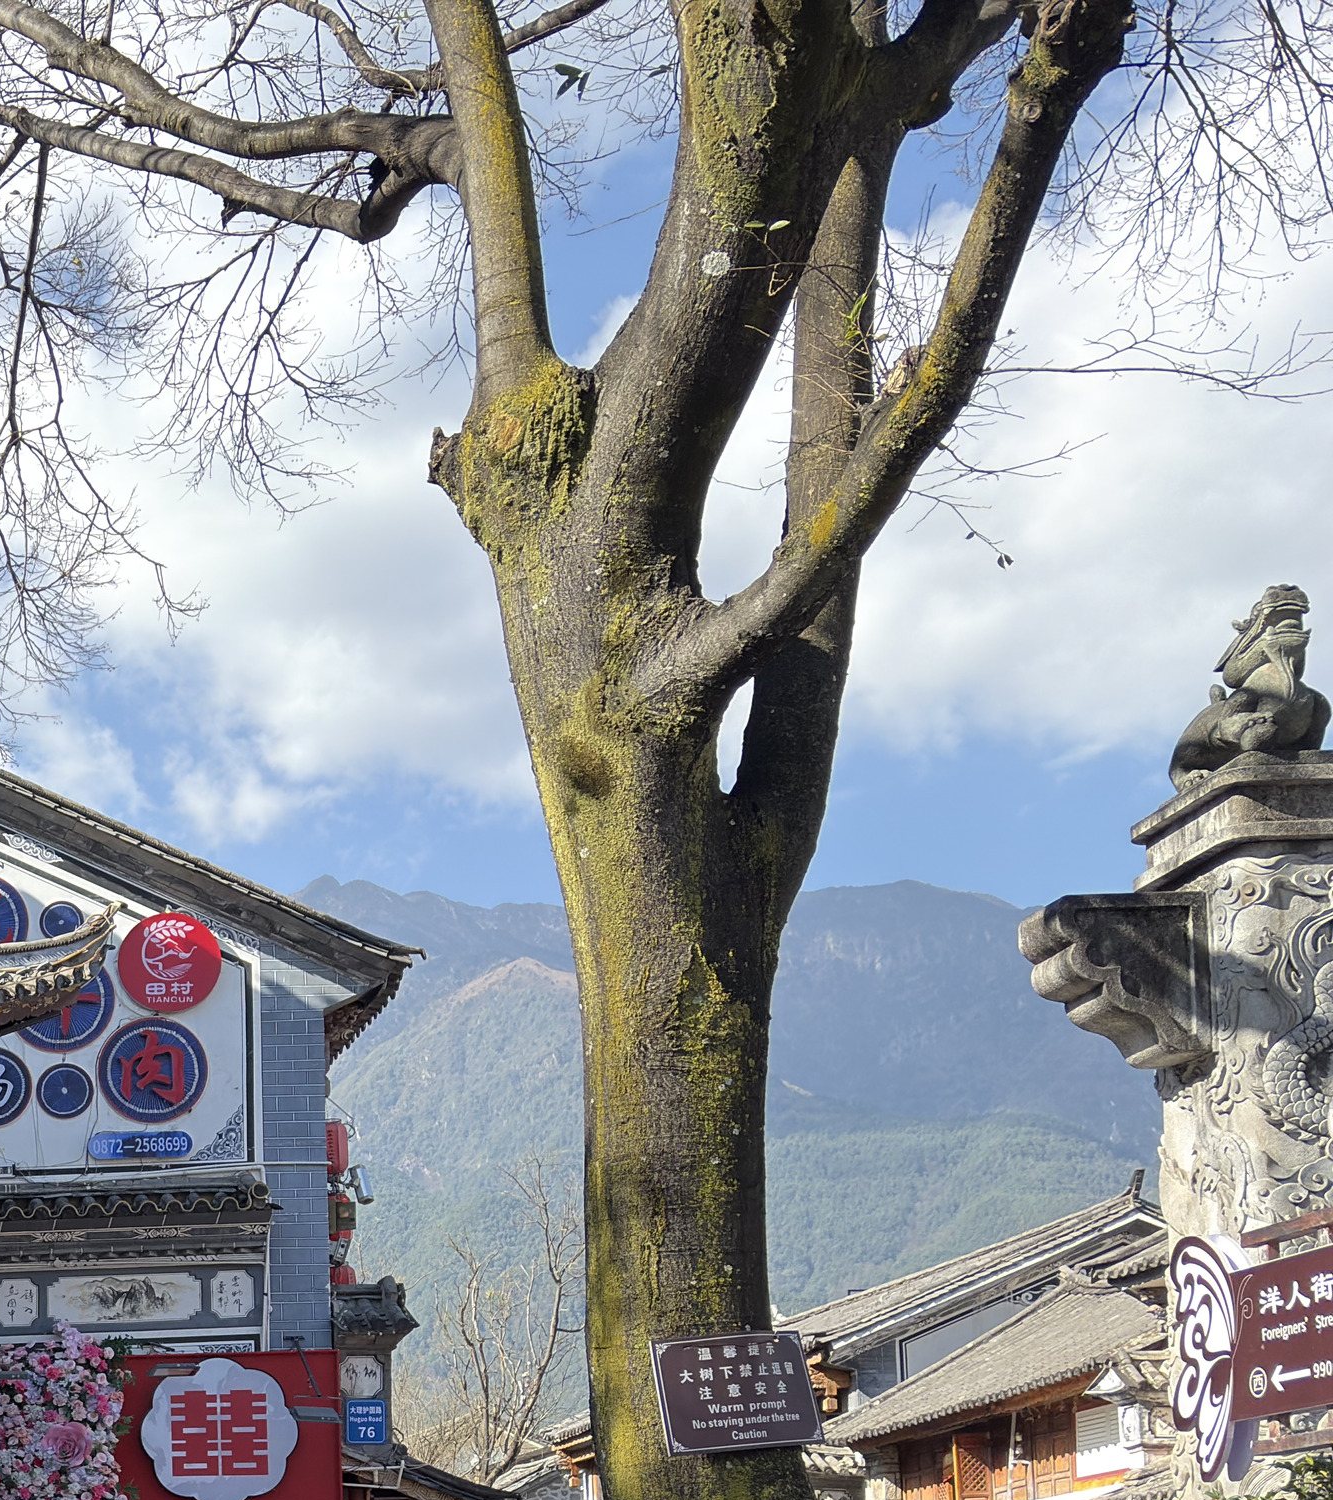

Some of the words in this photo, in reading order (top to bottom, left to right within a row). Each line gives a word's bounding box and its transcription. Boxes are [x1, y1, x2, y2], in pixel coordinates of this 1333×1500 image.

[146, 981, 194, 996] 田村
[146, 996, 194, 1004] TIANCUN
[118, 1029, 184, 1105] 肉
[1259, 1272, 1333, 1314] 洋人街
[1315, 1314, 1333, 1333] Stre
[698, 1342, 776, 1361] 温馨提示
[679, 1361, 795, 1384] 大树下禁止逗留
[699, 1380, 788, 1400] 注意安全
[349, 1406, 383, 1415] 大理护国路
[708, 1402, 745, 1414] Warm
[750, 1399, 787, 1412] prompt
[349, 1415, 367, 1424] Huguo
[368, 1415, 383, 1423] Road
[692, 1419, 707, 1430] No
[708, 1416, 744, 1430] staying
[745, 1415, 771, 1425] under
[771, 1413, 785, 1423] the
[785, 1412, 801, 1421] tree
[357, 1426, 376, 1438] 76
[731, 1429, 768, 1440] Caution
